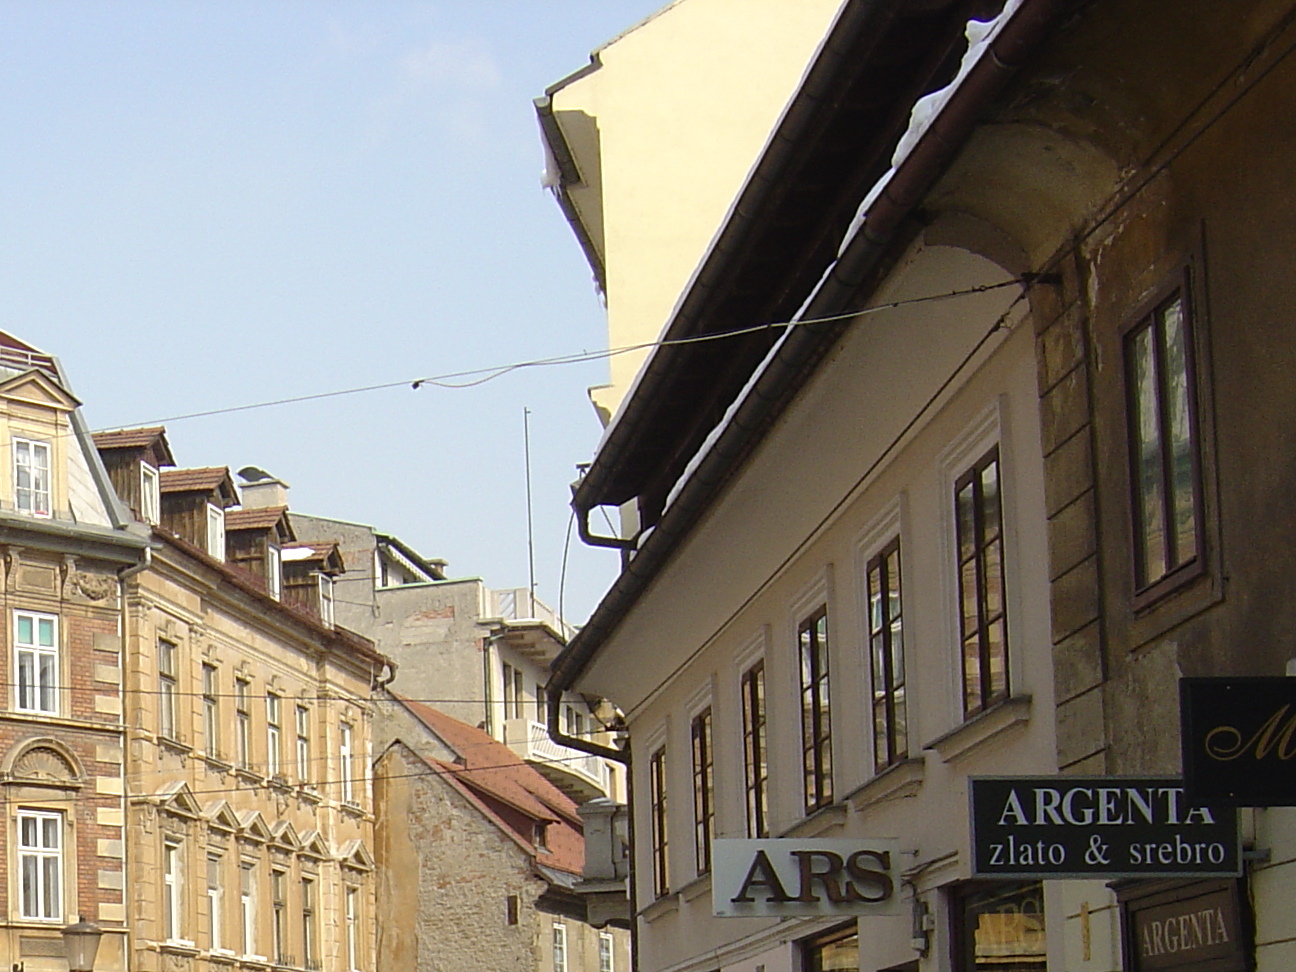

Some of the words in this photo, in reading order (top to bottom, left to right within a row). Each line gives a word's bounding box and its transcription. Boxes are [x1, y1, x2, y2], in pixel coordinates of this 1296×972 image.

[997, 787, 1215, 826] ARGENTA
[989, 835, 1066, 866] zlato
[1084, 834, 1110, 865] &
[1129, 834, 1225, 865] srebro
[730, 850, 895, 904] ARS
[1143, 907, 1229, 957] ARGENTA
